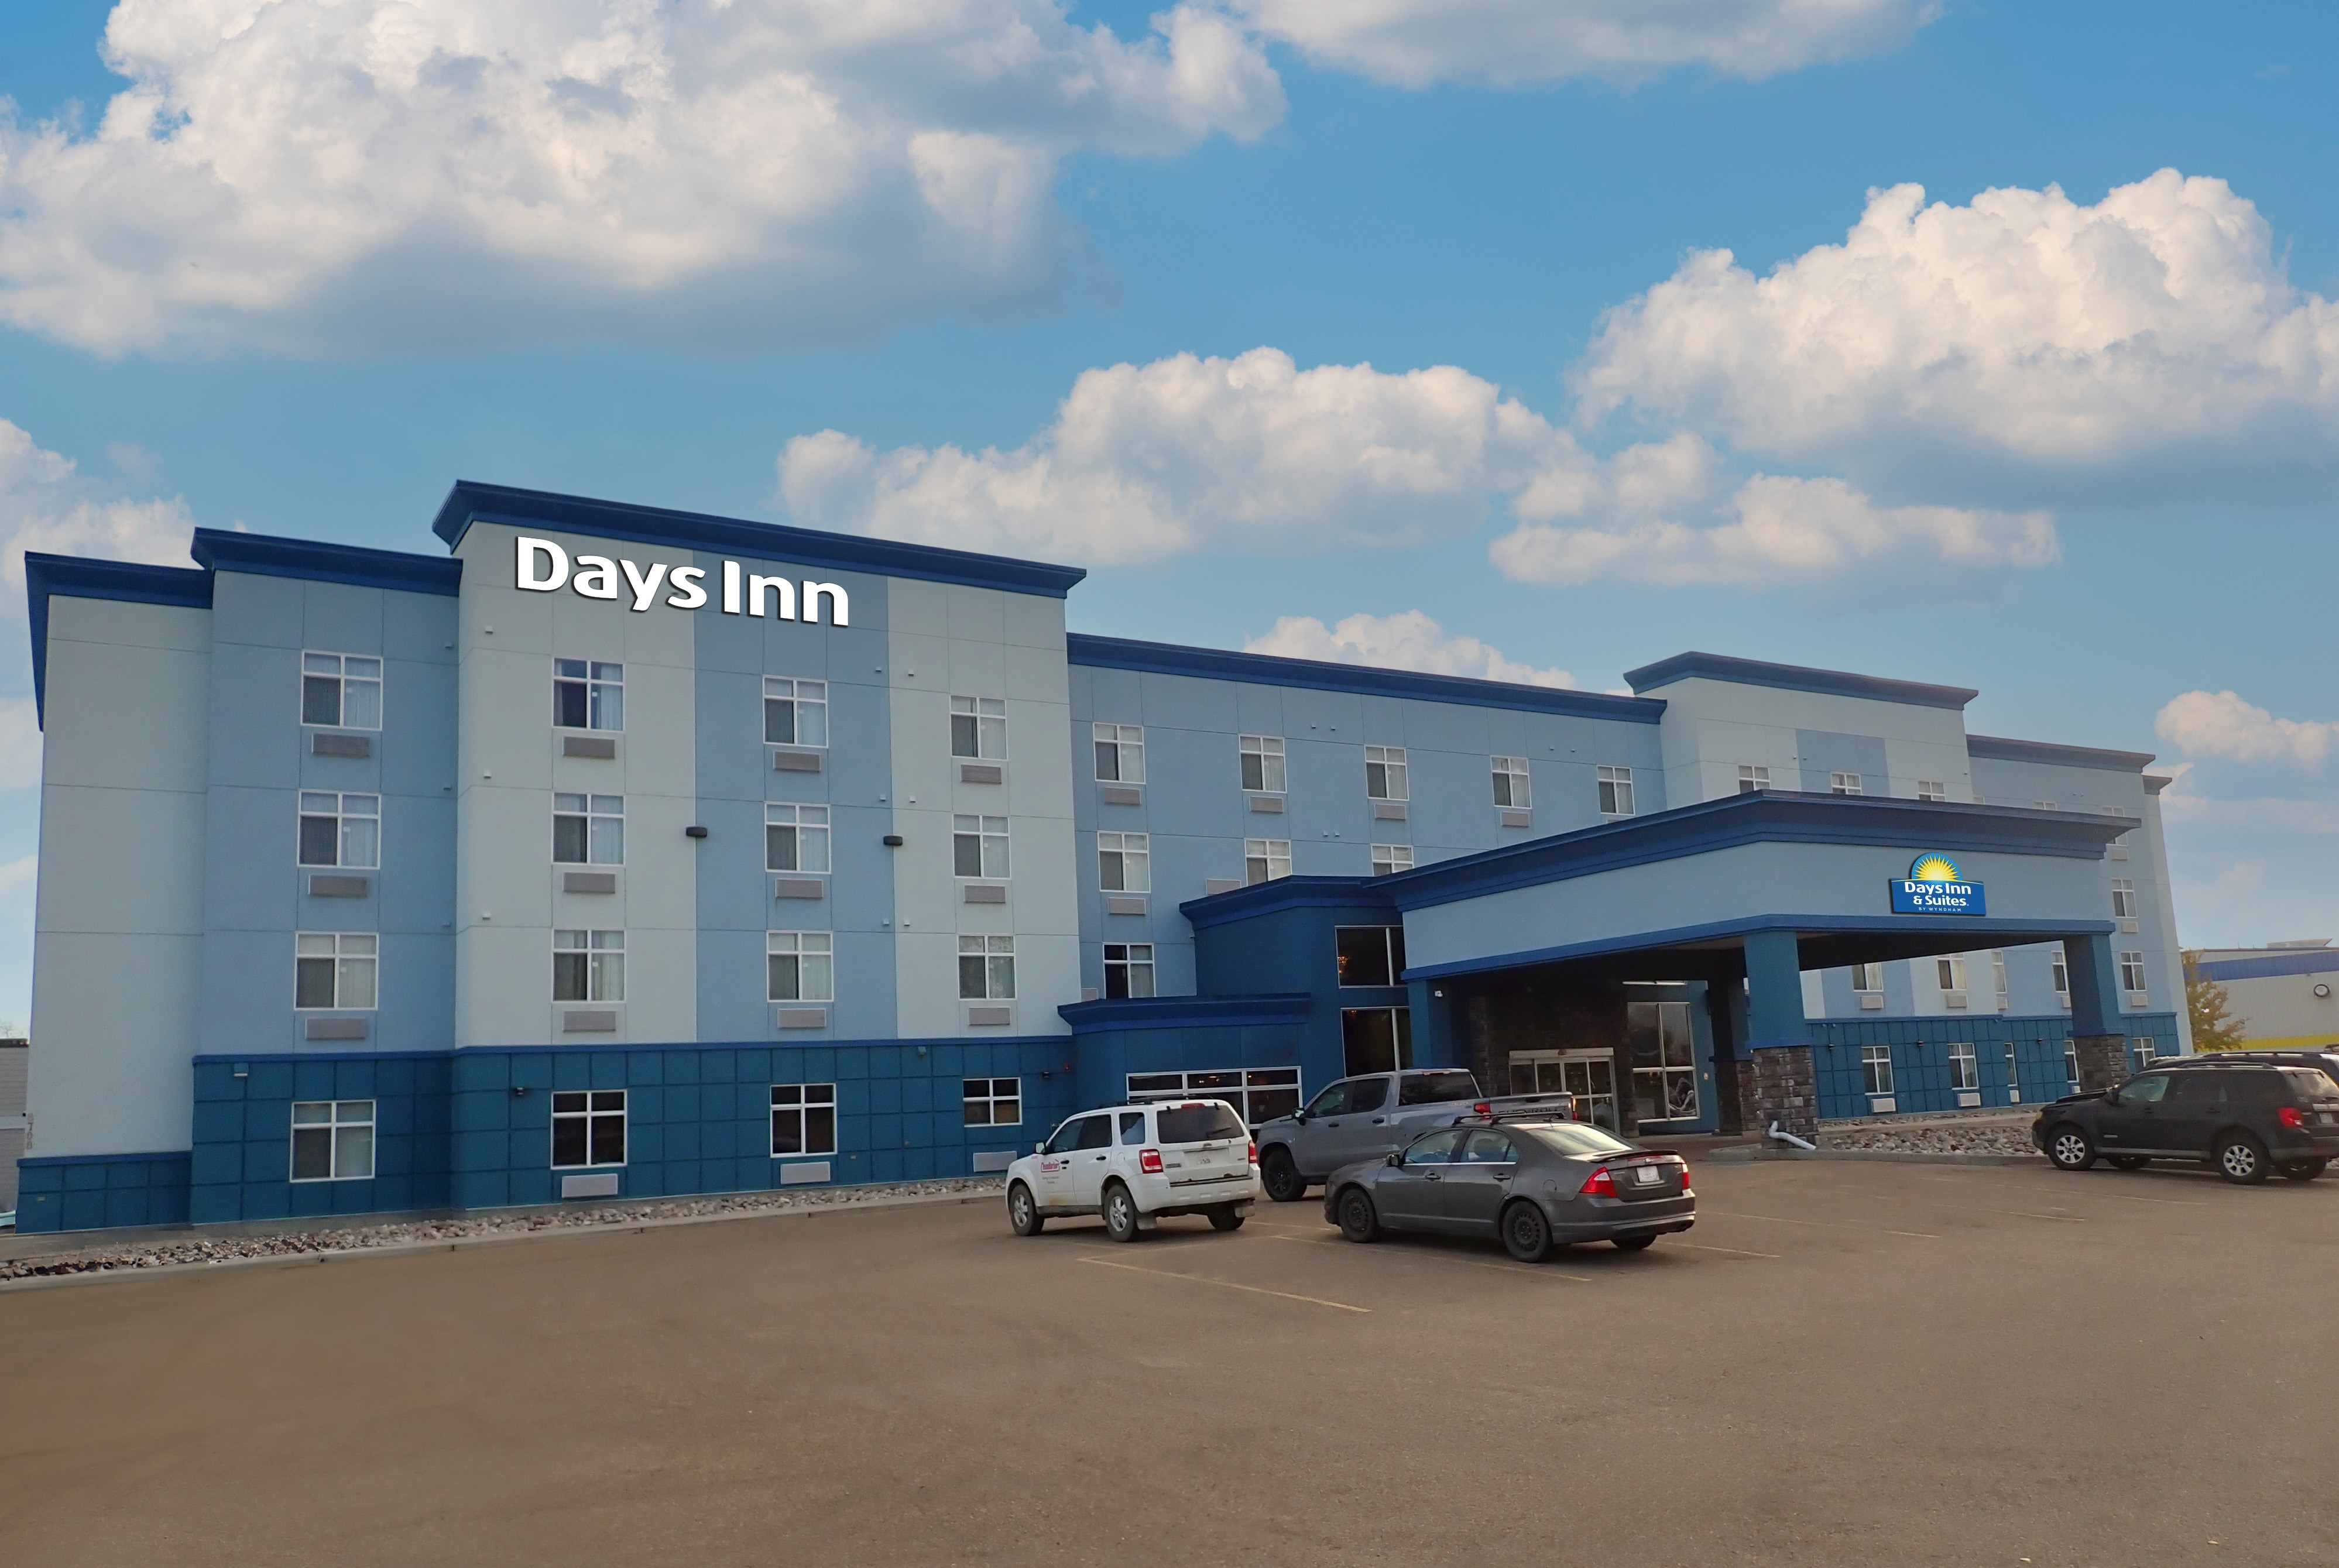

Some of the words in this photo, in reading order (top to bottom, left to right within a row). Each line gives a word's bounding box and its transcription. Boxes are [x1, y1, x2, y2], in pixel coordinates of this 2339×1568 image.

[517, 536, 708, 611] Days
[723, 560, 849, 626] Inn
[1904, 881, 1943, 895] Days
[1945, 883, 1971, 895] Inn
[1913, 895, 1923, 905] &
[1925, 894, 1967, 906] Suites
